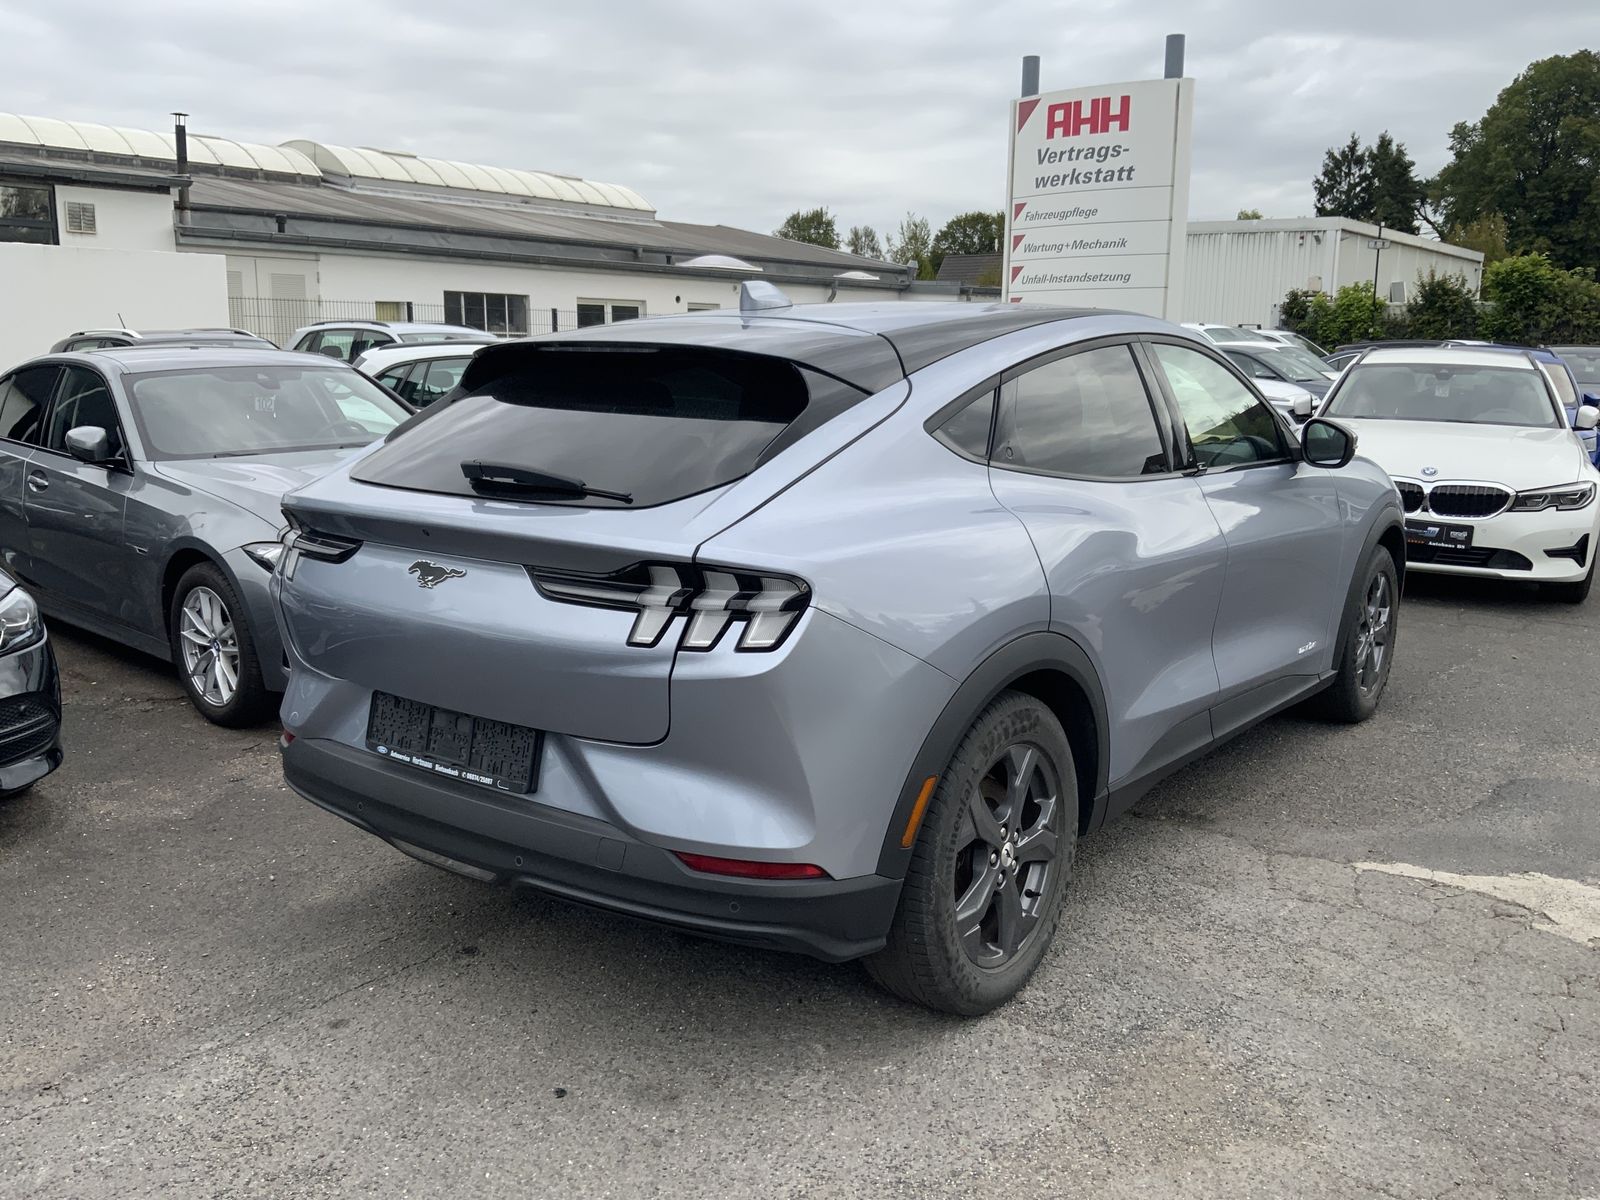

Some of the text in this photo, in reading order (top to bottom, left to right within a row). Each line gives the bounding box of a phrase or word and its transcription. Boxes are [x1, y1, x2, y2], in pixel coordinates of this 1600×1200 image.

[1046, 95, 1131, 140] AHH
[1036, 144, 1130, 165] Vertrags-
[1034, 164, 1135, 189] werkstatt
[1024, 206, 1098, 222] Fahrzeugpflege
[1023, 238, 1128, 254] Wartung+Mechanik
[1021, 272, 1131, 285] Unfall-Instandsetzung
